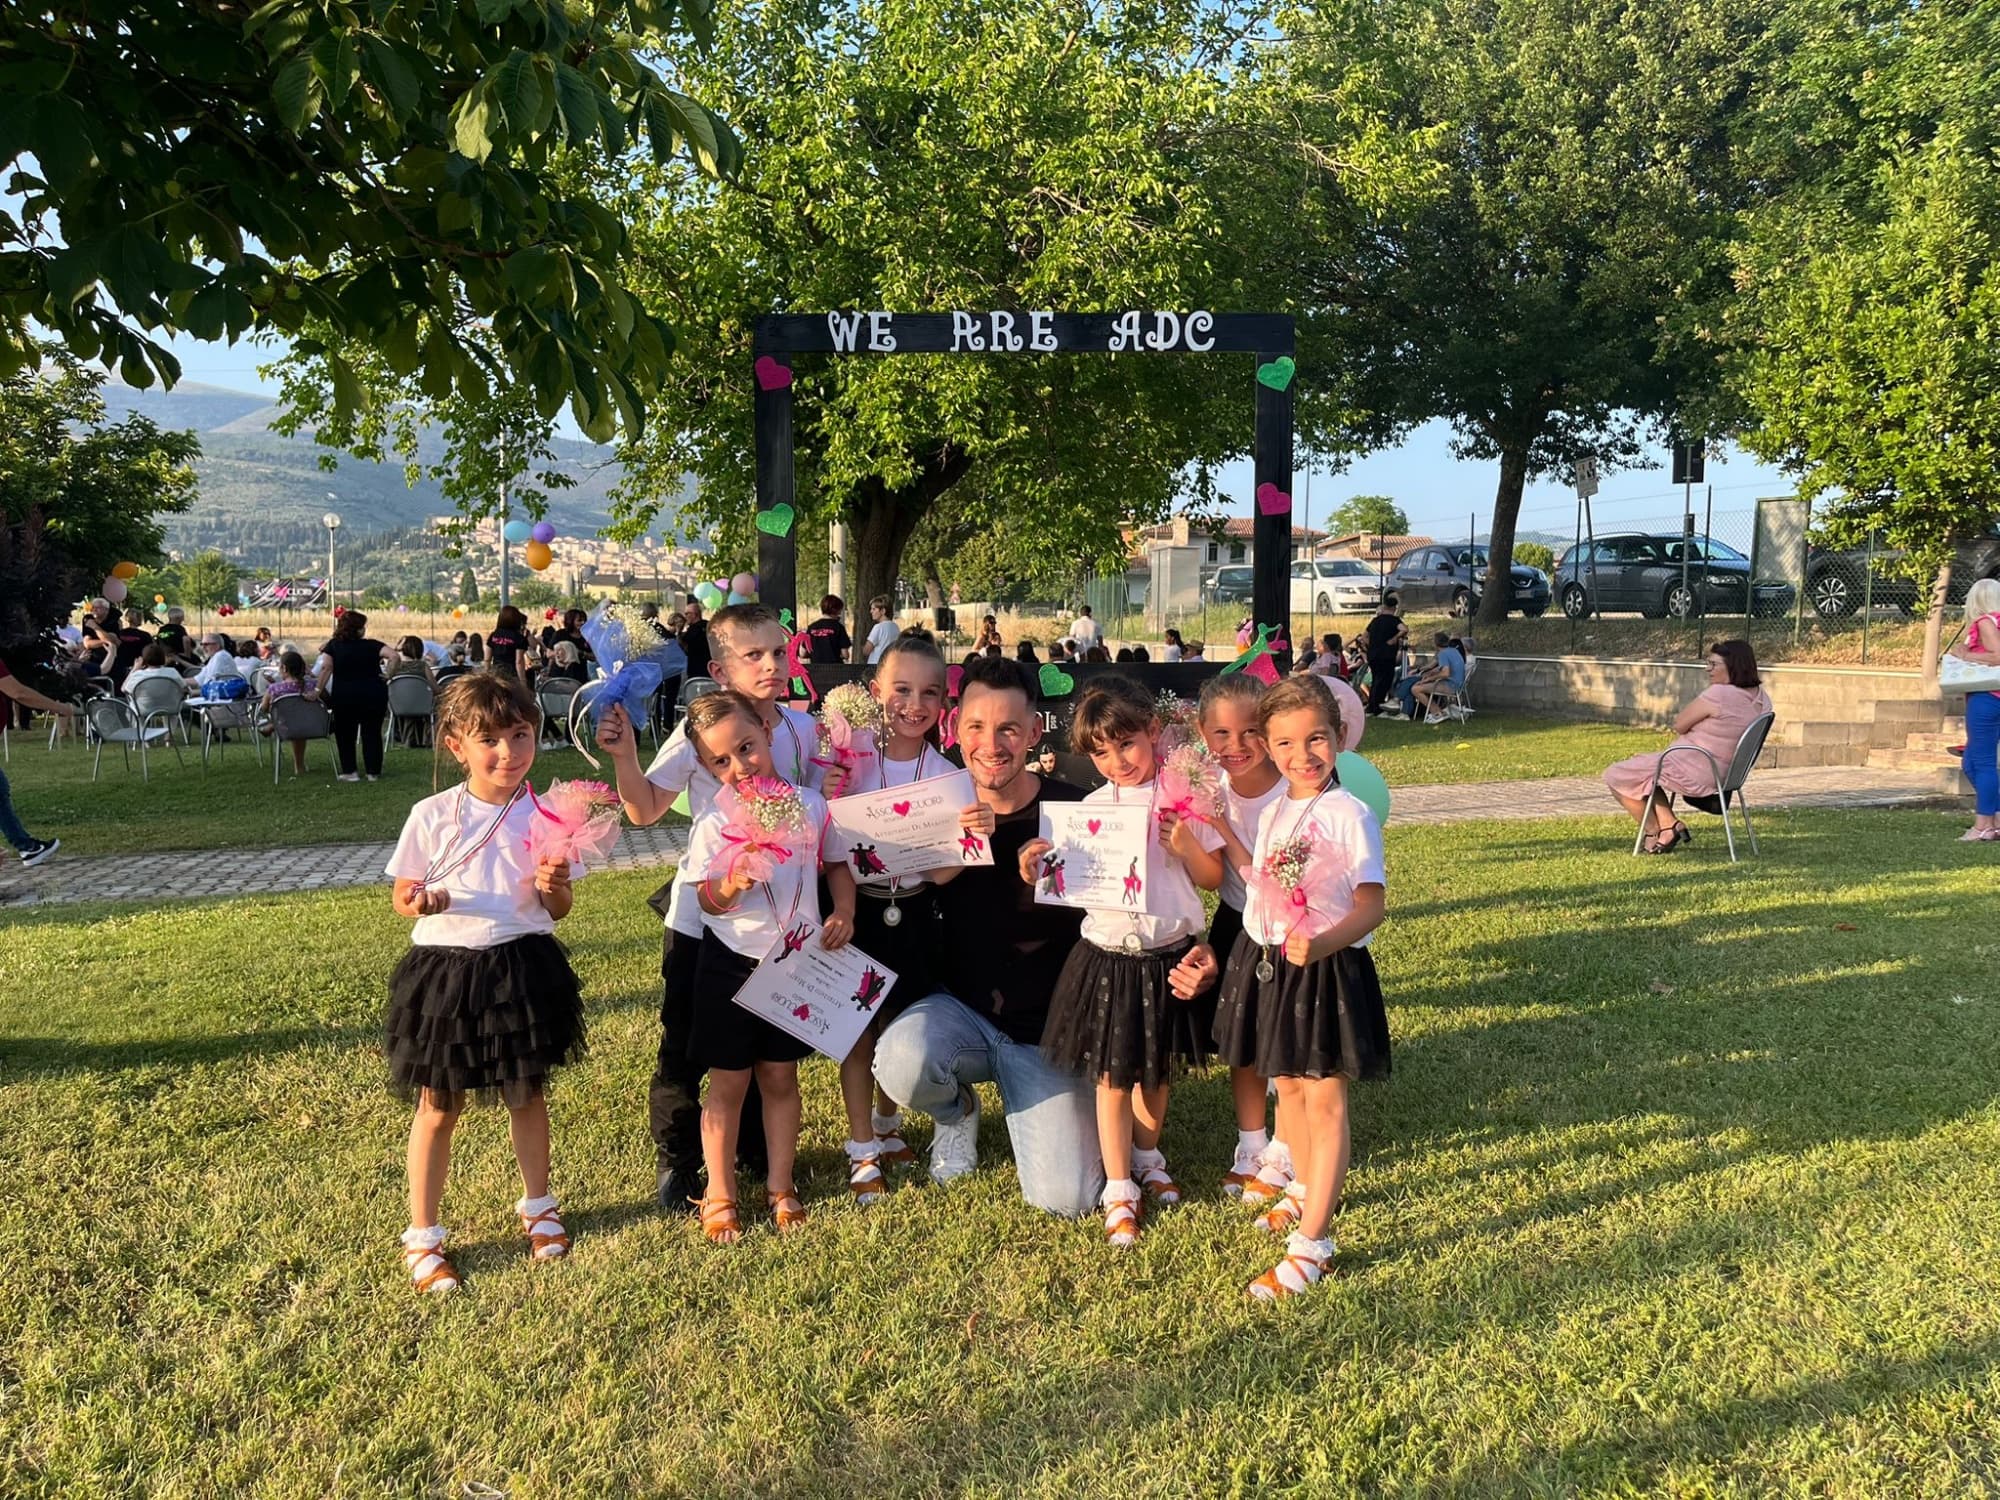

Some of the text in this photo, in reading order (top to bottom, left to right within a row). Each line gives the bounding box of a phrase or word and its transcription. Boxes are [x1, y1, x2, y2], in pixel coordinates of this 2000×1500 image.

[827, 309, 1216, 352] WE ARE ADC
